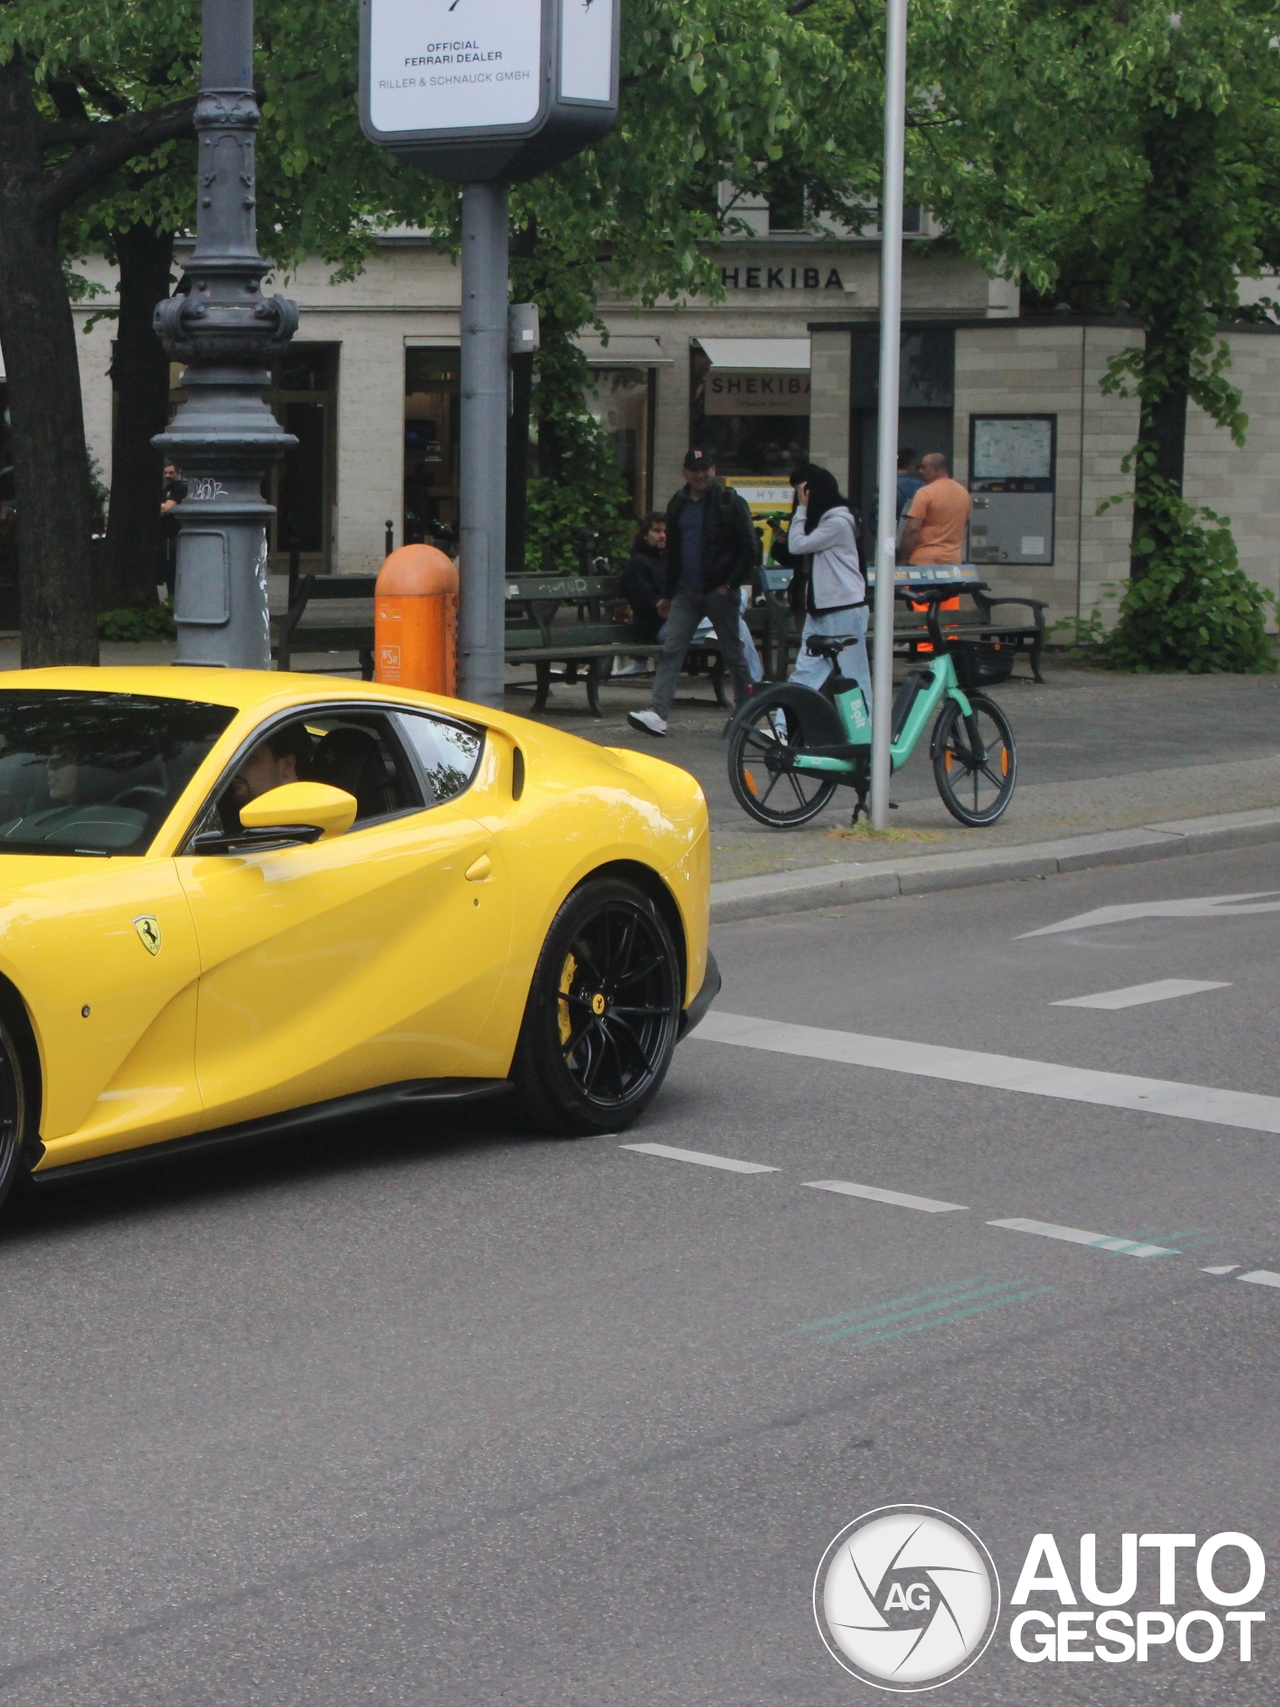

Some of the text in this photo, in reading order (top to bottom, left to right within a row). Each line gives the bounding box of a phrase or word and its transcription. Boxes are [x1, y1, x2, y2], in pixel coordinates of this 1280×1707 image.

[426, 40, 480, 53] OFFICIAL
[404, 51, 503, 67] FERRARI DEALER
[378, 70, 531, 90] RILLER & SCHNAUCK GMBH
[720, 267, 844, 289] HEKIBA
[850, 699, 866, 729] Bolt
